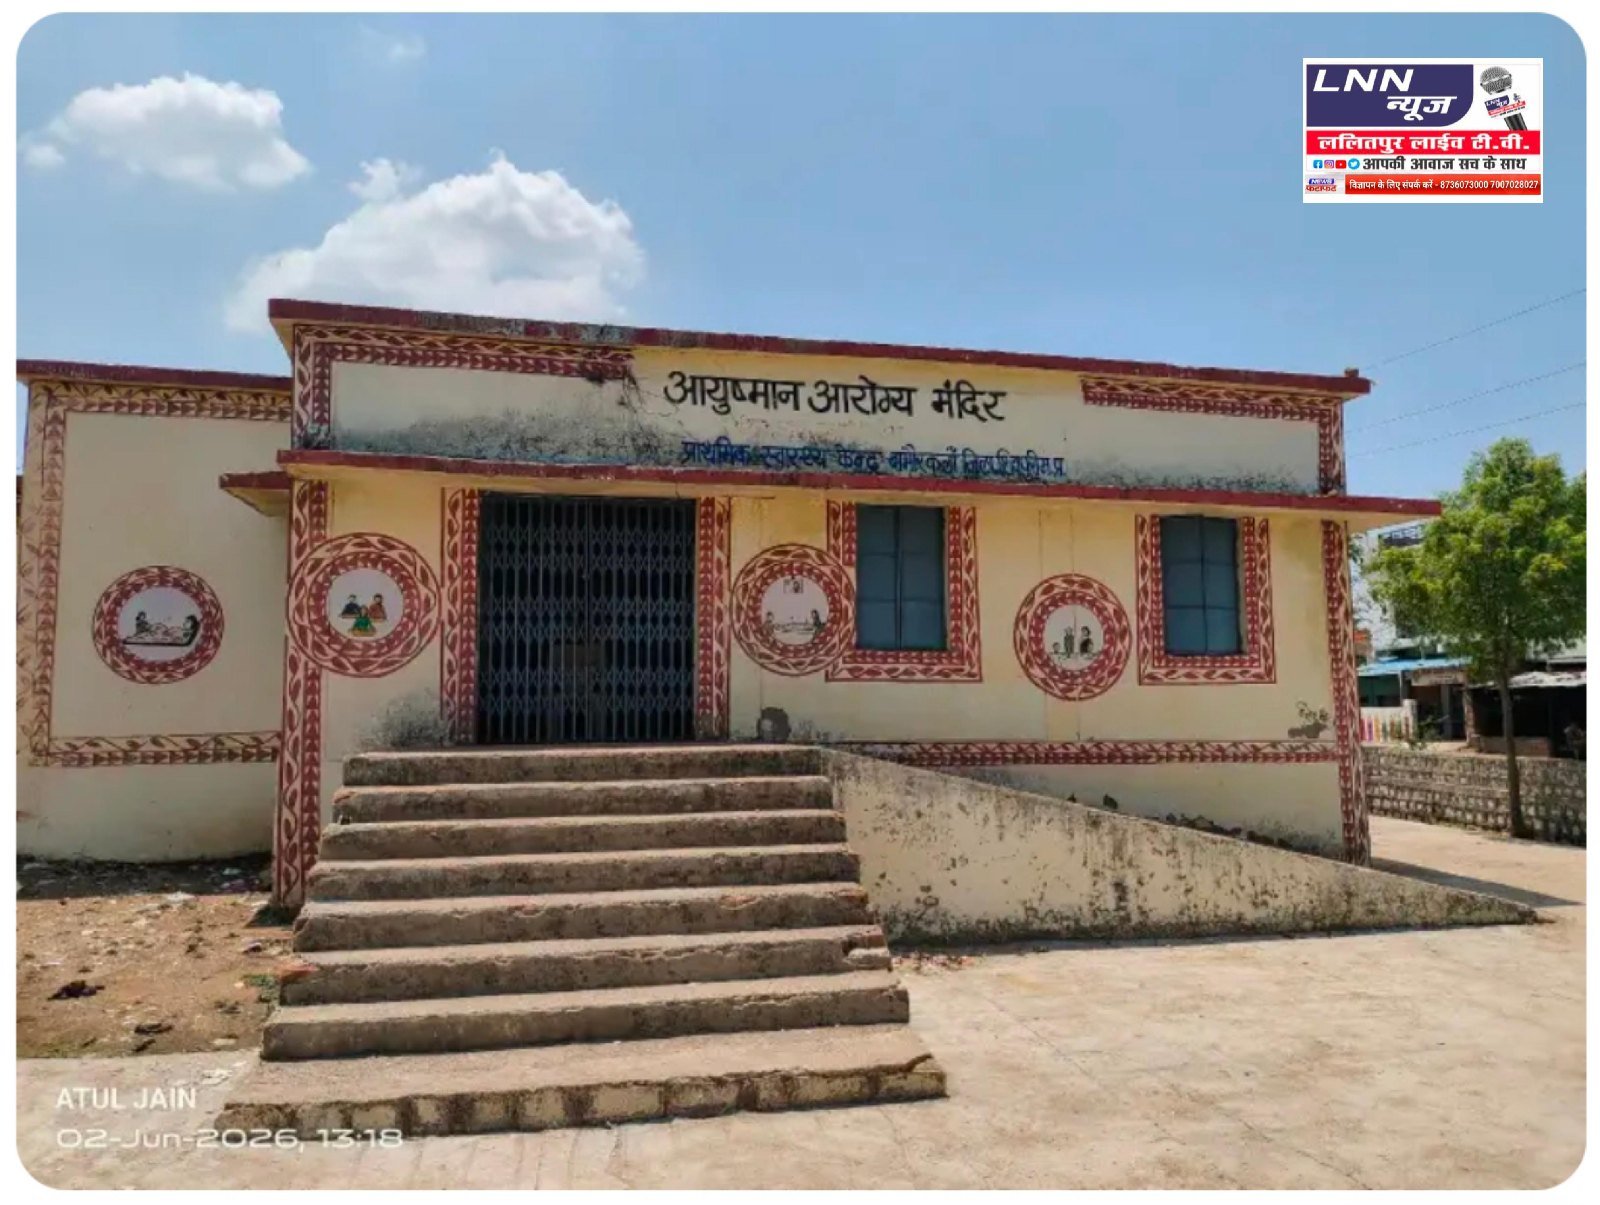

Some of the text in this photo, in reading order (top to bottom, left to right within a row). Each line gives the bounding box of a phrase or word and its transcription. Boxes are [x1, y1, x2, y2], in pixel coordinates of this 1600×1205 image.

[663, 371, 1007, 422] आयुष्मान आरोग्य मंदिर
